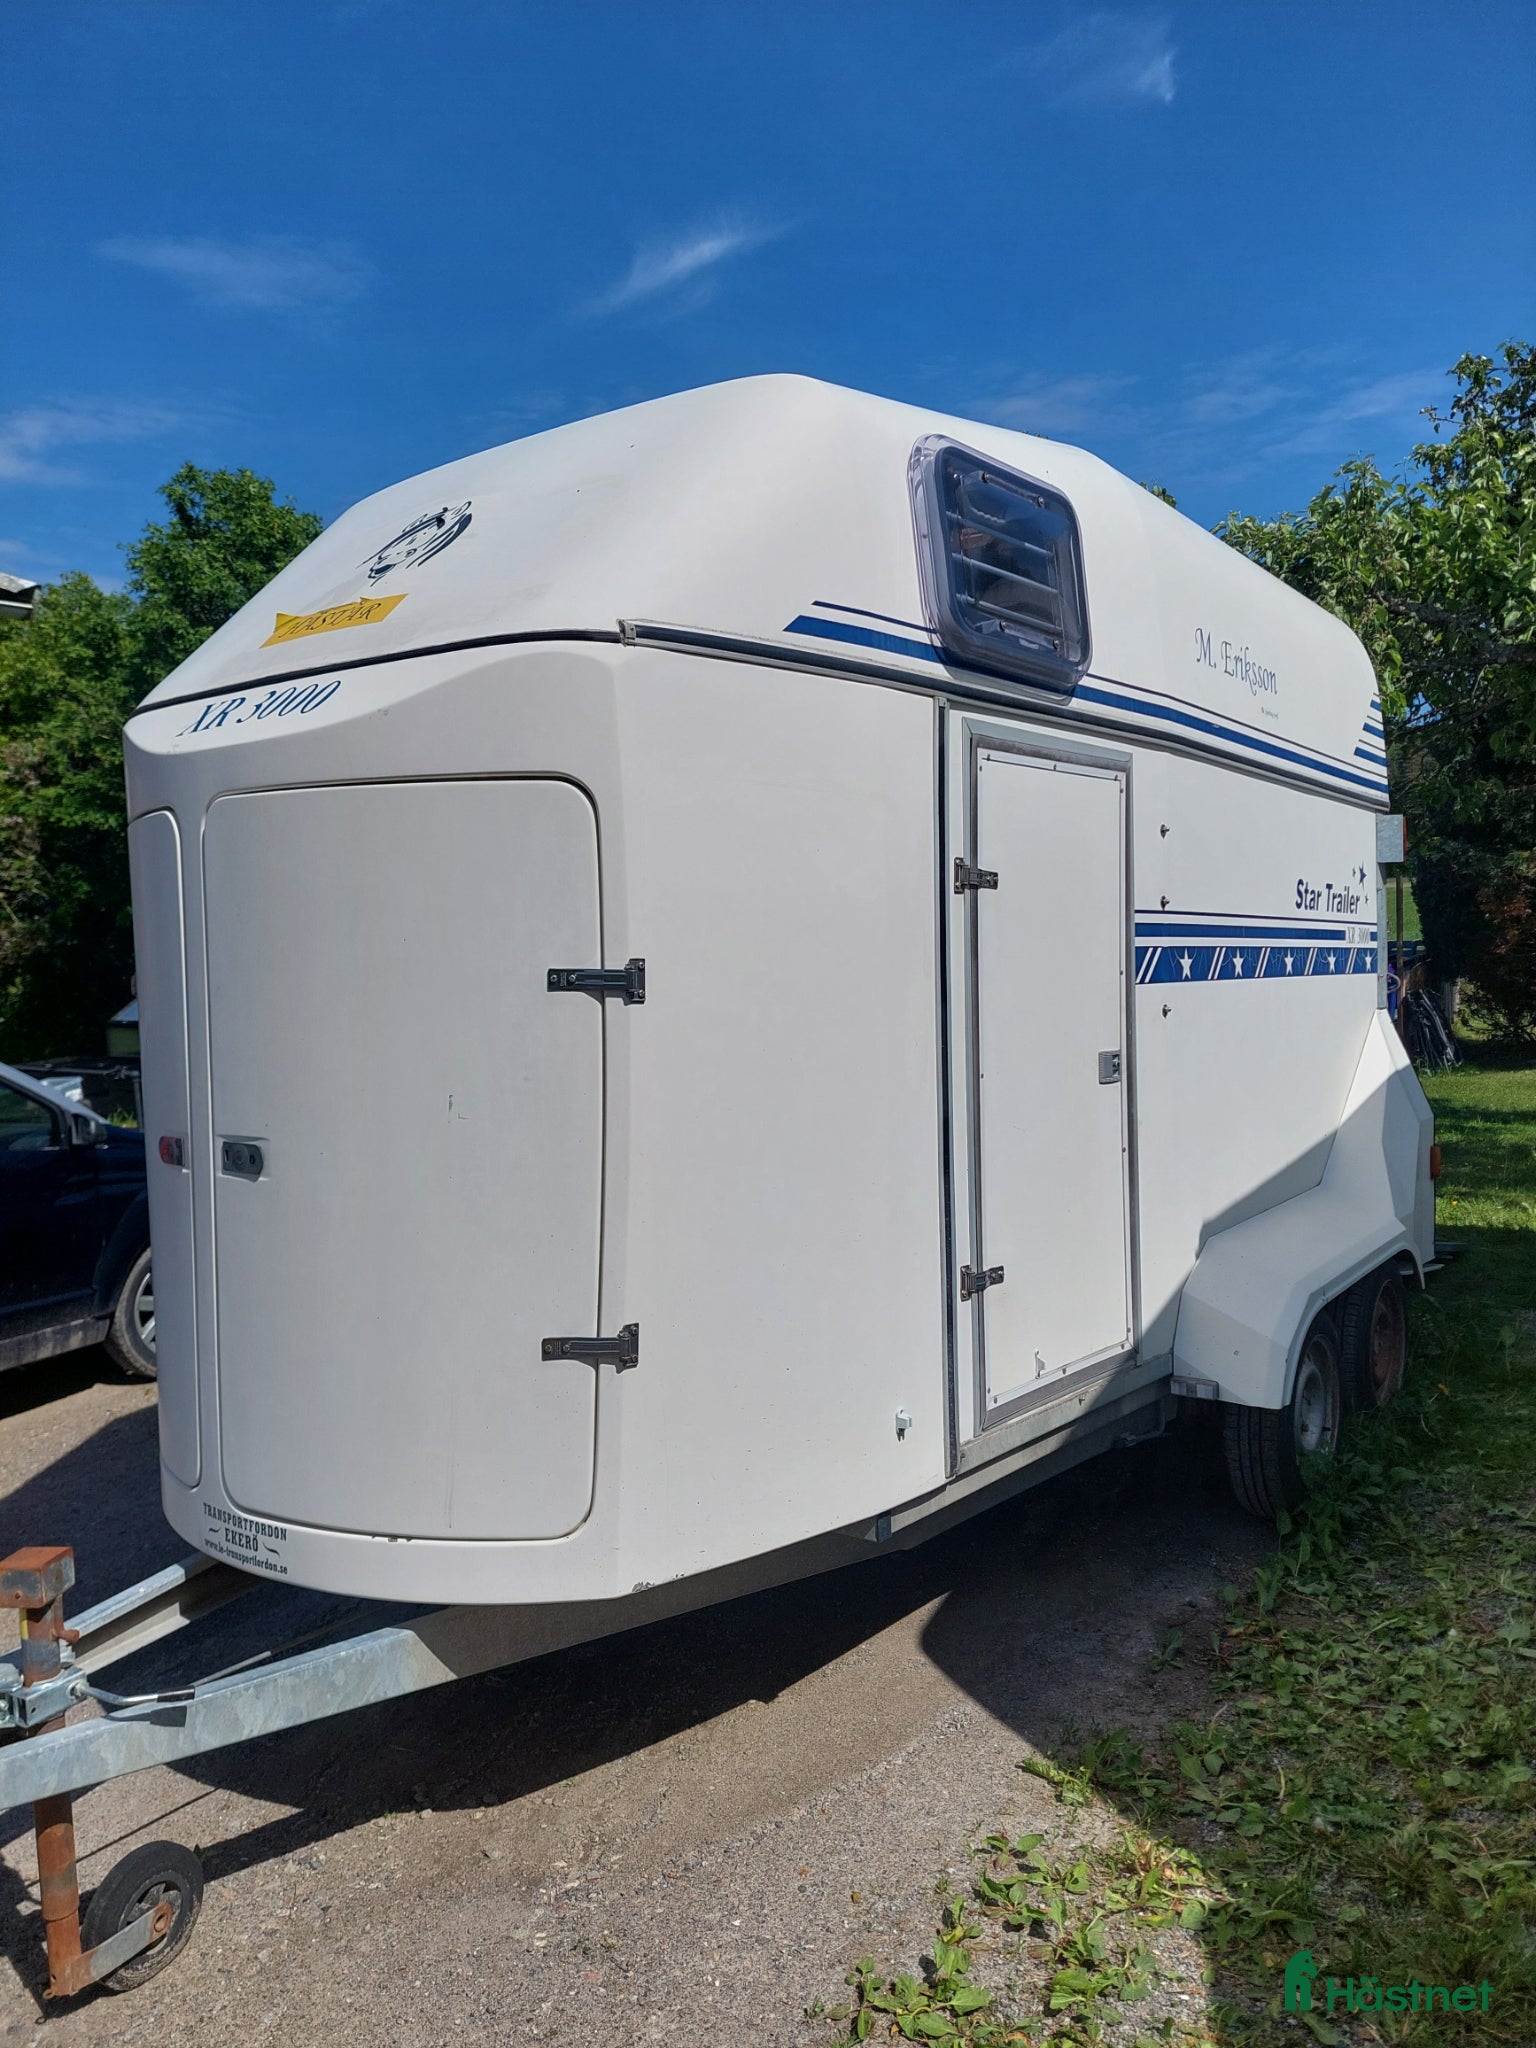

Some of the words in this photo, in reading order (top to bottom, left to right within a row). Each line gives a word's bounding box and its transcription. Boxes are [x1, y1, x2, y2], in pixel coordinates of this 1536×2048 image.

[1194, 627, 1217, 669] M.
[1220, 640, 1278, 697] Eriksson
[175, 697, 247, 738] XR
[235, 680, 342, 724] 3000
[1295, 878, 1322, 912] Star
[1325, 882, 1361, 915] Trailer
[203, 1502, 288, 1541] TRANSPORTFORDON
[224, 1527, 259, 1553] EKERÖ
